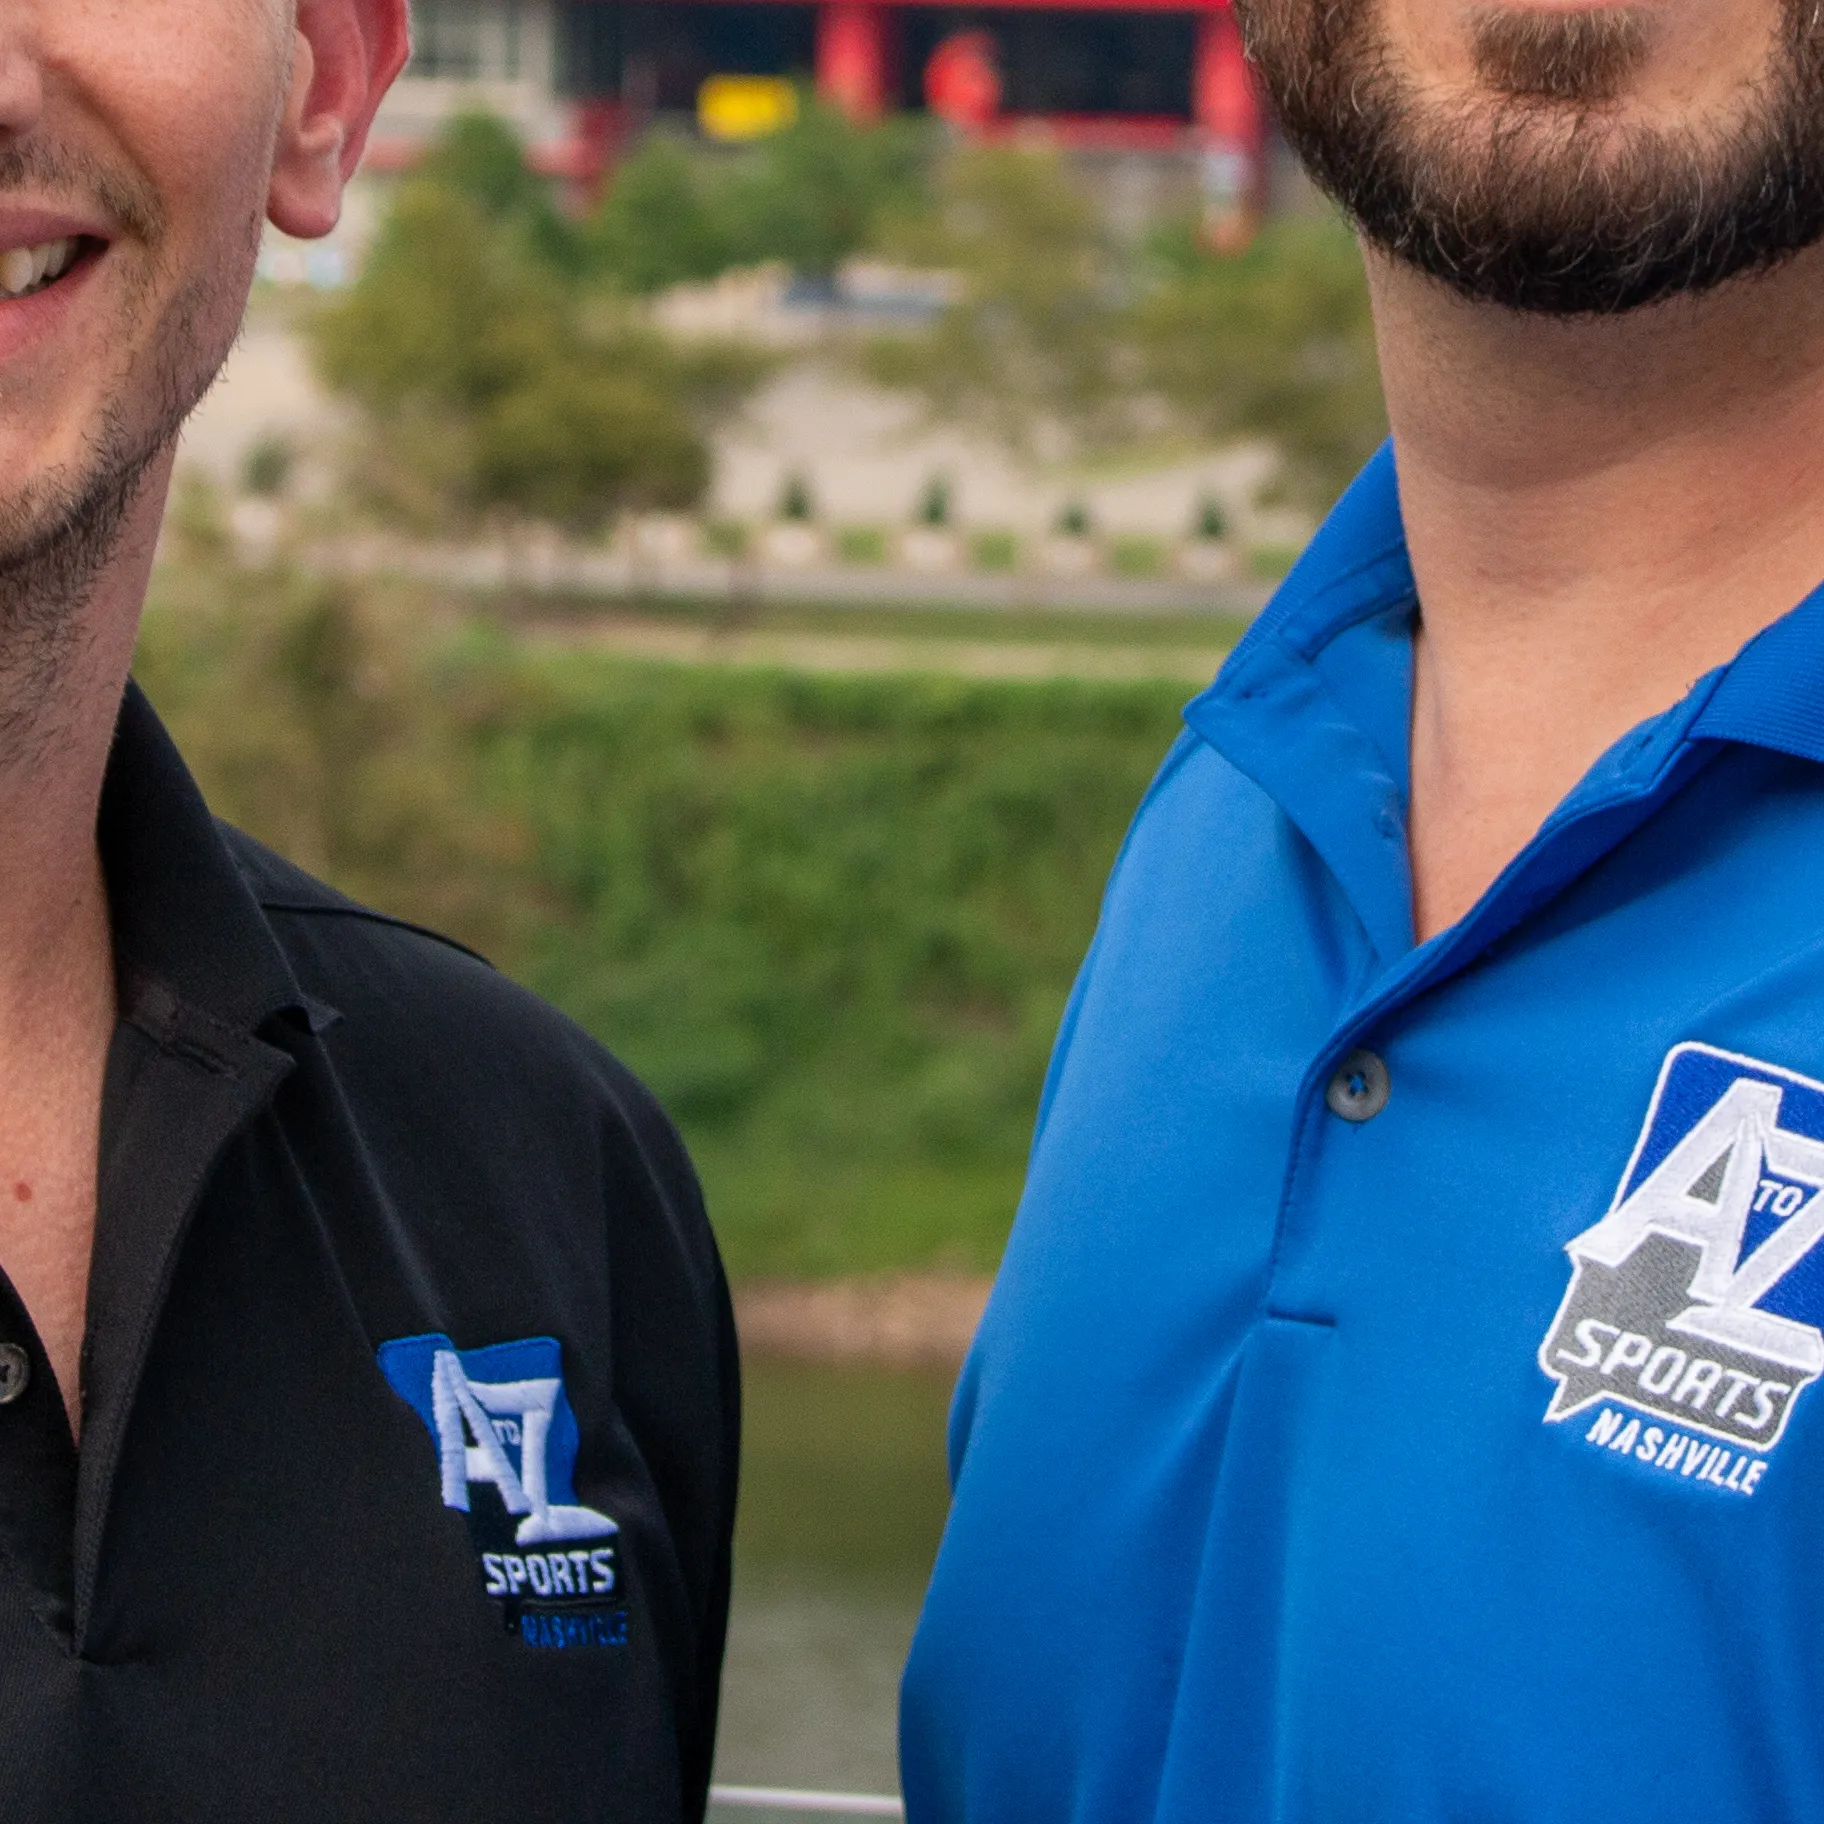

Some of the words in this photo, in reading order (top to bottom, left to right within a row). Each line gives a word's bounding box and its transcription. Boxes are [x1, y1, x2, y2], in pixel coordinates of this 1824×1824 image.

[1754, 1179, 1802, 1216] TO
[1556, 1319, 1791, 1432] SPORTS
[1586, 1409, 1768, 1495] NASHVILLE
[482, 1548, 615, 1596] SPORTS
